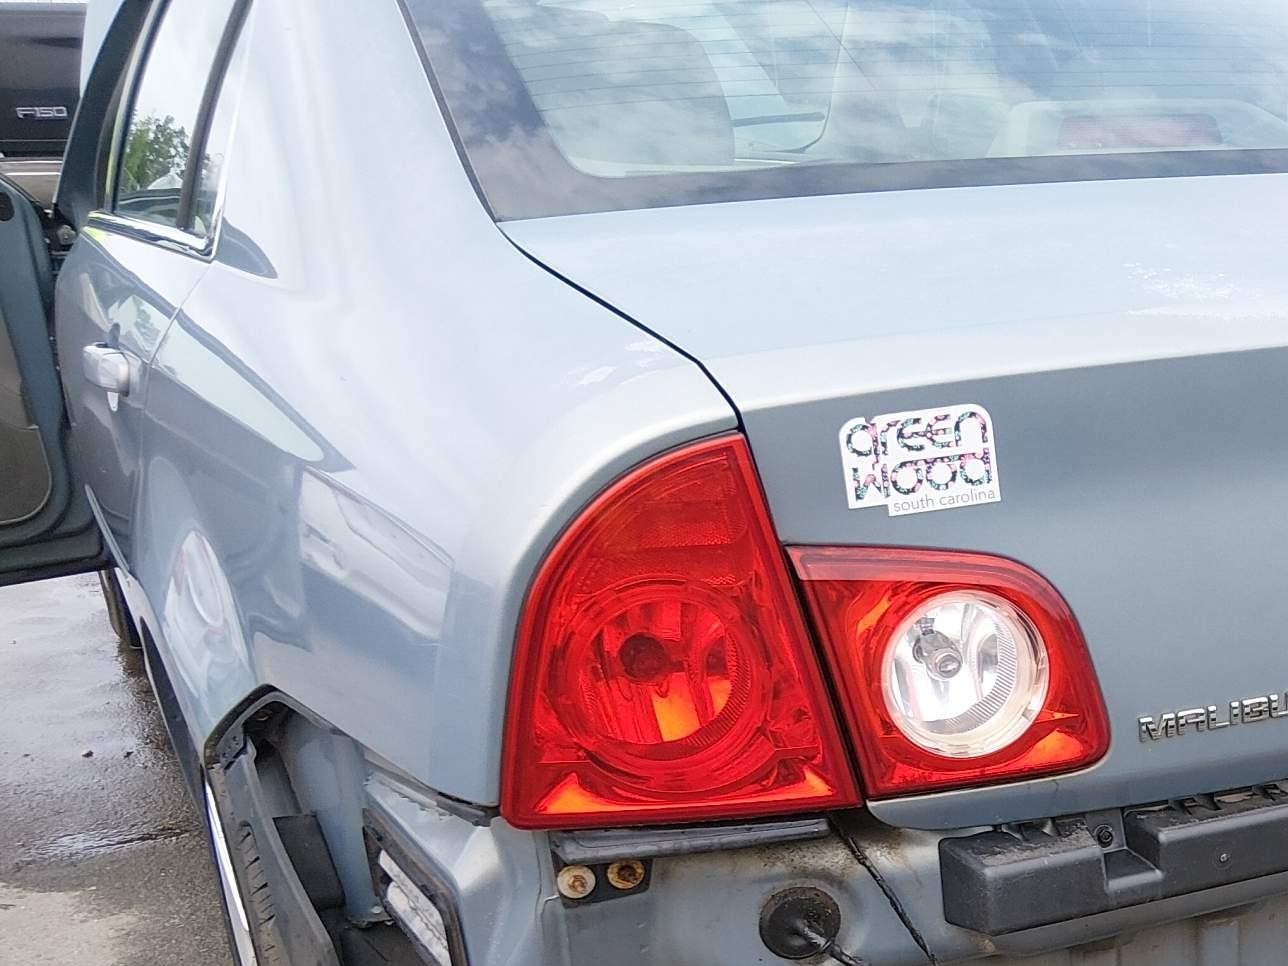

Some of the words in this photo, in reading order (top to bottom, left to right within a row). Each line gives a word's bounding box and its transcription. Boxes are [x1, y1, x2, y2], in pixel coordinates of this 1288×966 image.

[846, 411, 988, 470] green
[852, 447, 992, 501] wood
[893, 494, 936, 512] south
[939, 488, 995, 506] carolina
